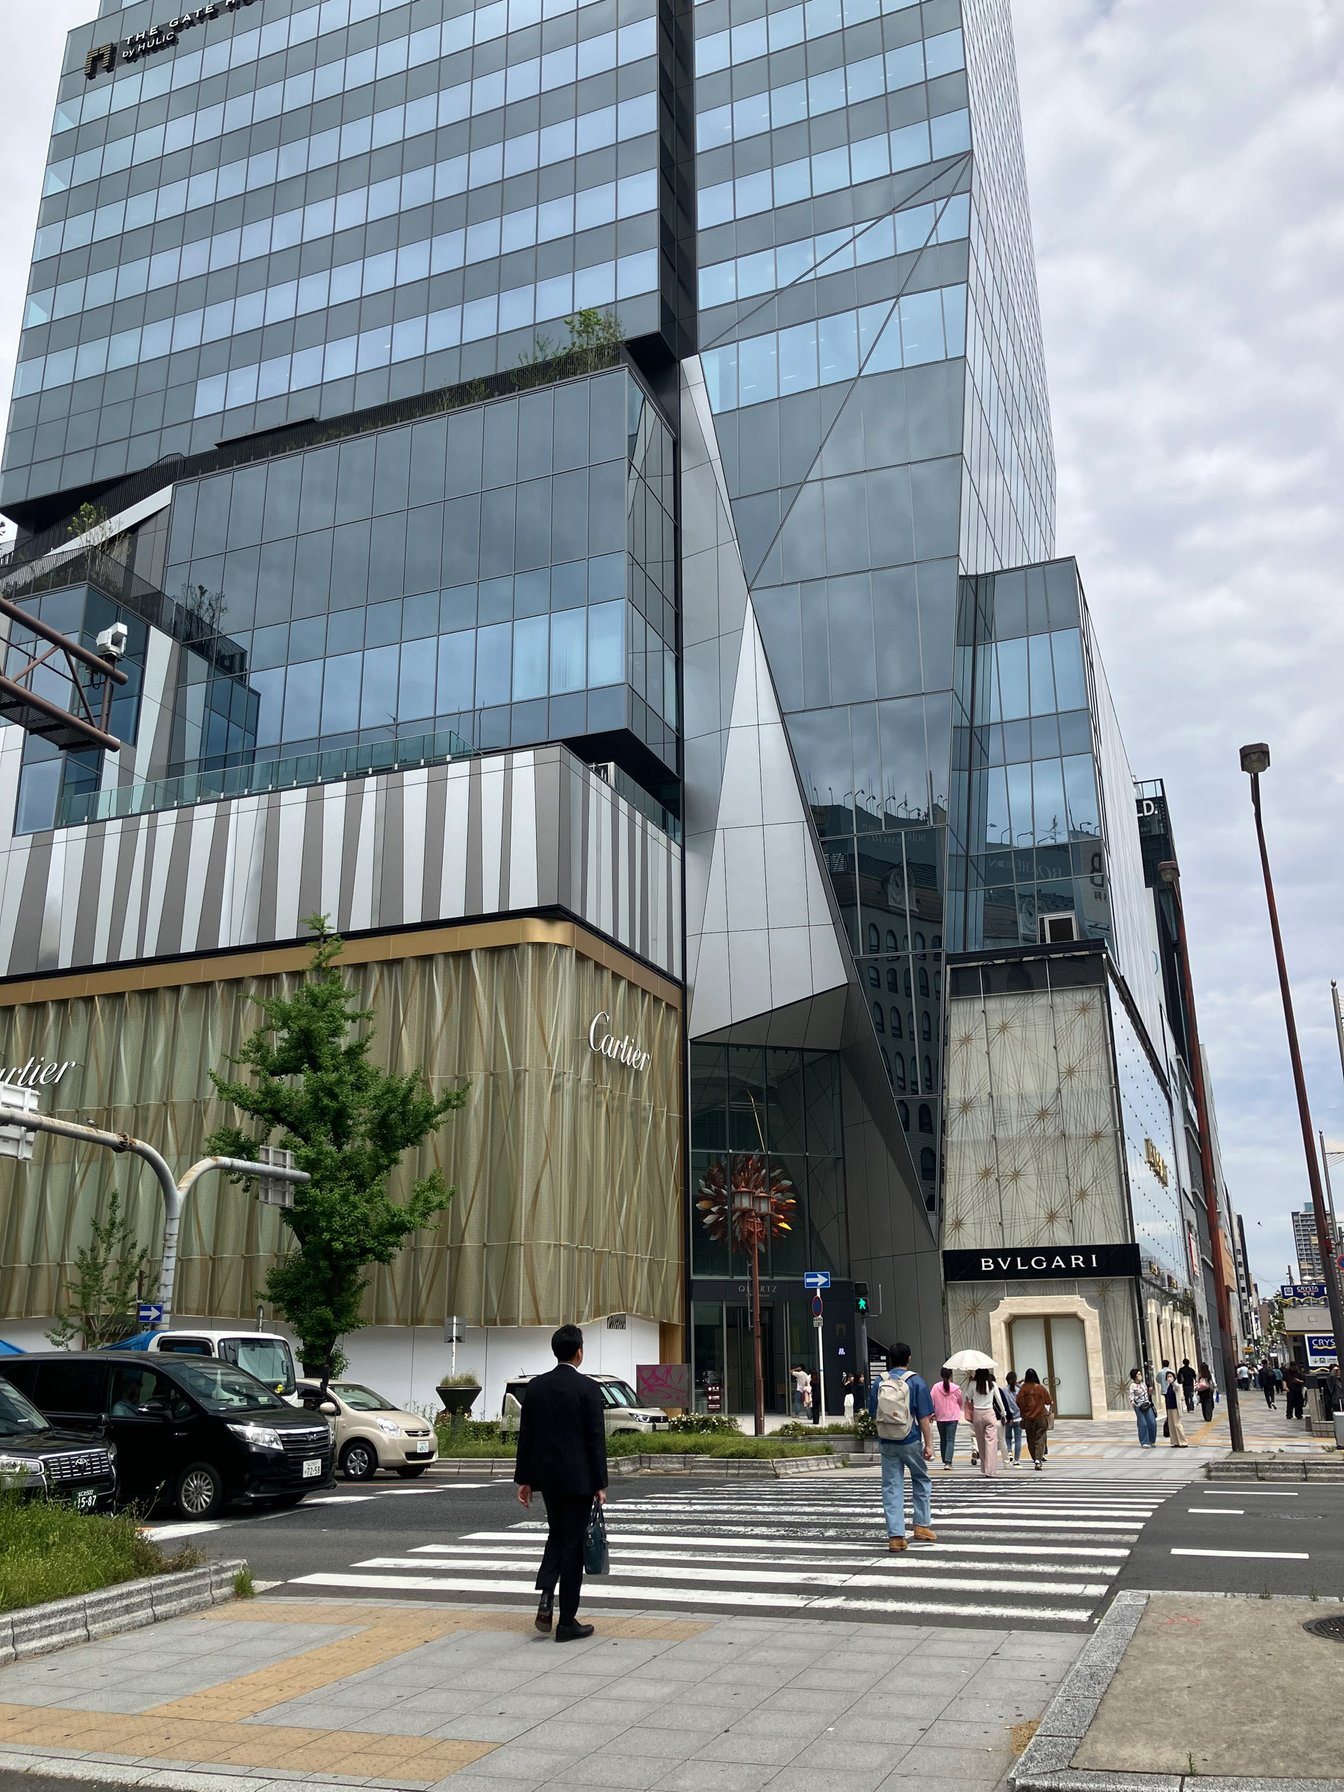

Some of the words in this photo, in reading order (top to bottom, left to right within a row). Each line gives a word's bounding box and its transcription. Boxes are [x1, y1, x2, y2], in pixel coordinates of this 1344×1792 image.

[125, 25, 159, 45] THE
[169, 3, 215, 28] GATE
[122, 48, 135, 58] by
[137, 31, 175, 53] HULIC
[589, 1011, 650, 1071] Cartier
[0, 1056, 76, 1087] rtier
[980, 1254, 1098, 1271] BVLGARI
[738, 1285, 777, 1293] QRTZ
[1311, 1338, 1336, 1346] CRYS
